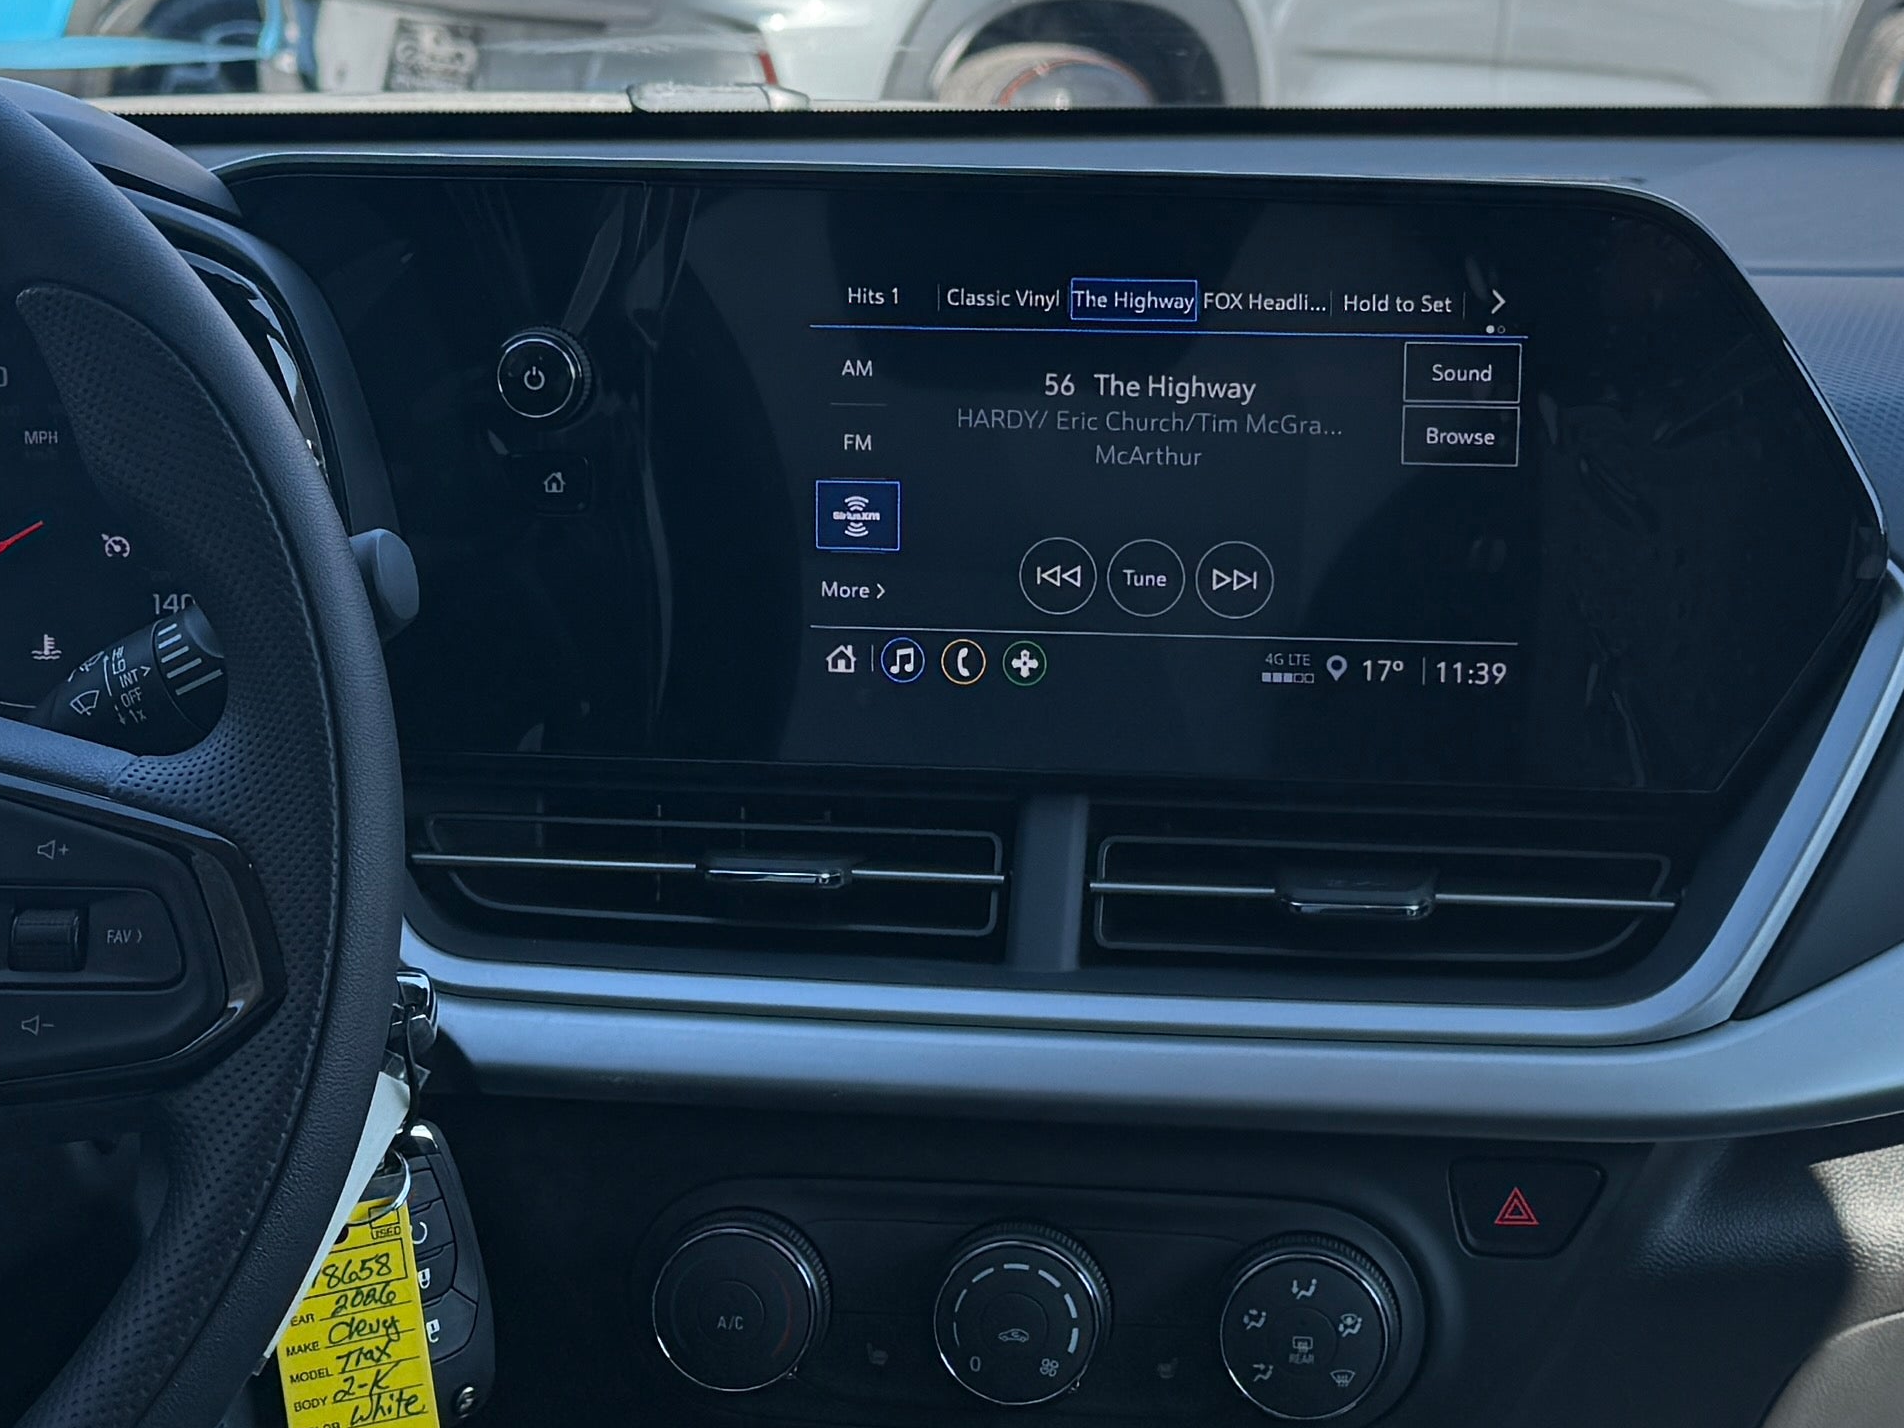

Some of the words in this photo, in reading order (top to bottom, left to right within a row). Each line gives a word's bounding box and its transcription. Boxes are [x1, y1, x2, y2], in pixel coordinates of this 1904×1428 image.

[847, 286, 885, 305] Hits
[891, 286, 899, 305] 1
[946, 288, 1011, 308] Classic
[1015, 289, 1060, 312] Vinyl
[1075, 290, 1108, 309] The
[1114, 290, 1195, 314] Highway
[1203, 292, 1243, 310] FOX
[1248, 292, 1327, 312] Headli...
[1343, 294, 1389, 313] Hold
[1395, 297, 1415, 313] to
[1420, 294, 1453, 313] Set
[841, 359, 873, 377] AM
[1431, 362, 1493, 382] Sound
[1043, 373, 1075, 397] 56
[1093, 373, 1140, 397] The
[1147, 374, 1257, 406] Highway
[956, 408, 1048, 429] HARDY/
[1056, 410, 1098, 432] Eric
[1105, 411, 1238, 433] Church/Tim
[1245, 414, 1343, 436] McGra...
[24, 430, 59, 445] MPH
[843, 433, 872, 452] FM
[1425, 426, 1496, 446] Browse
[1095, 443, 1202, 467] McArthur
[1122, 568, 1168, 588] Tune
[820, 580, 871, 599] More
[152, 590, 195, 615] 140
[1264, 653, 1284, 667] 4G
[1288, 653, 1312, 667] LTE
[119, 668, 139, 688] INT
[1436, 660, 1508, 686] 11:39
[120, 687, 142, 708] OFF
[106, 928, 132, 944] FAV
[716, 1315, 744, 1331] A/C
[285, 1340, 321, 1357] MAKE
[289, 1366, 334, 1384] MODEL
[293, 1395, 329, 1413] BODY
[349, 1388, 427, 1426] White
